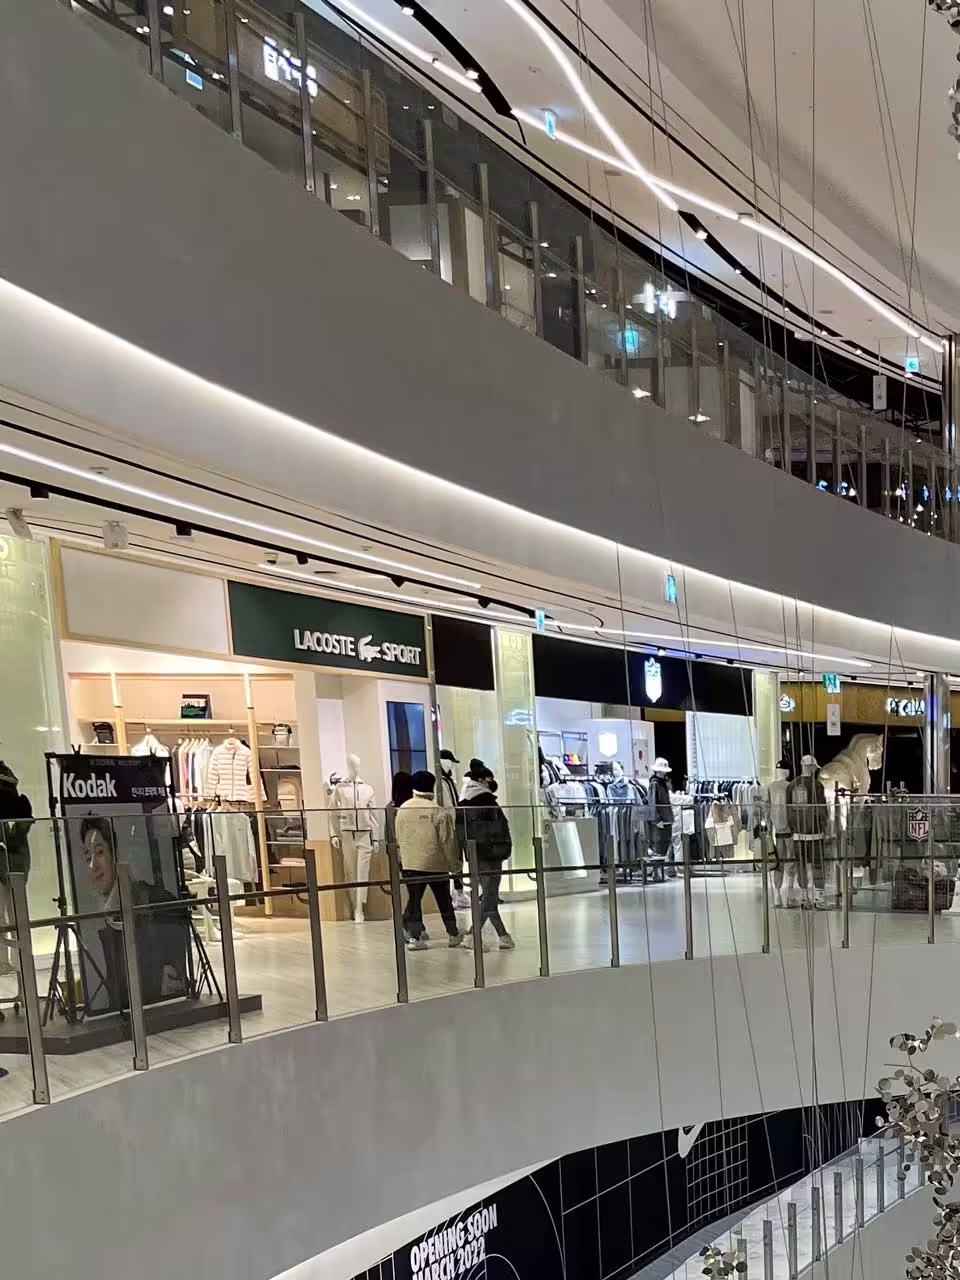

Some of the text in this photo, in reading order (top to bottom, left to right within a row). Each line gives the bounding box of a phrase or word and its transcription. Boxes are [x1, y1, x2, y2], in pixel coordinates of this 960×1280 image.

[293, 628, 421, 665] LACOSTE SPORT
[63, 772, 118, 798] Kodak
[410, 1203, 498, 1273] OPENING SOON
[457, 1236, 486, 1274] 2022
